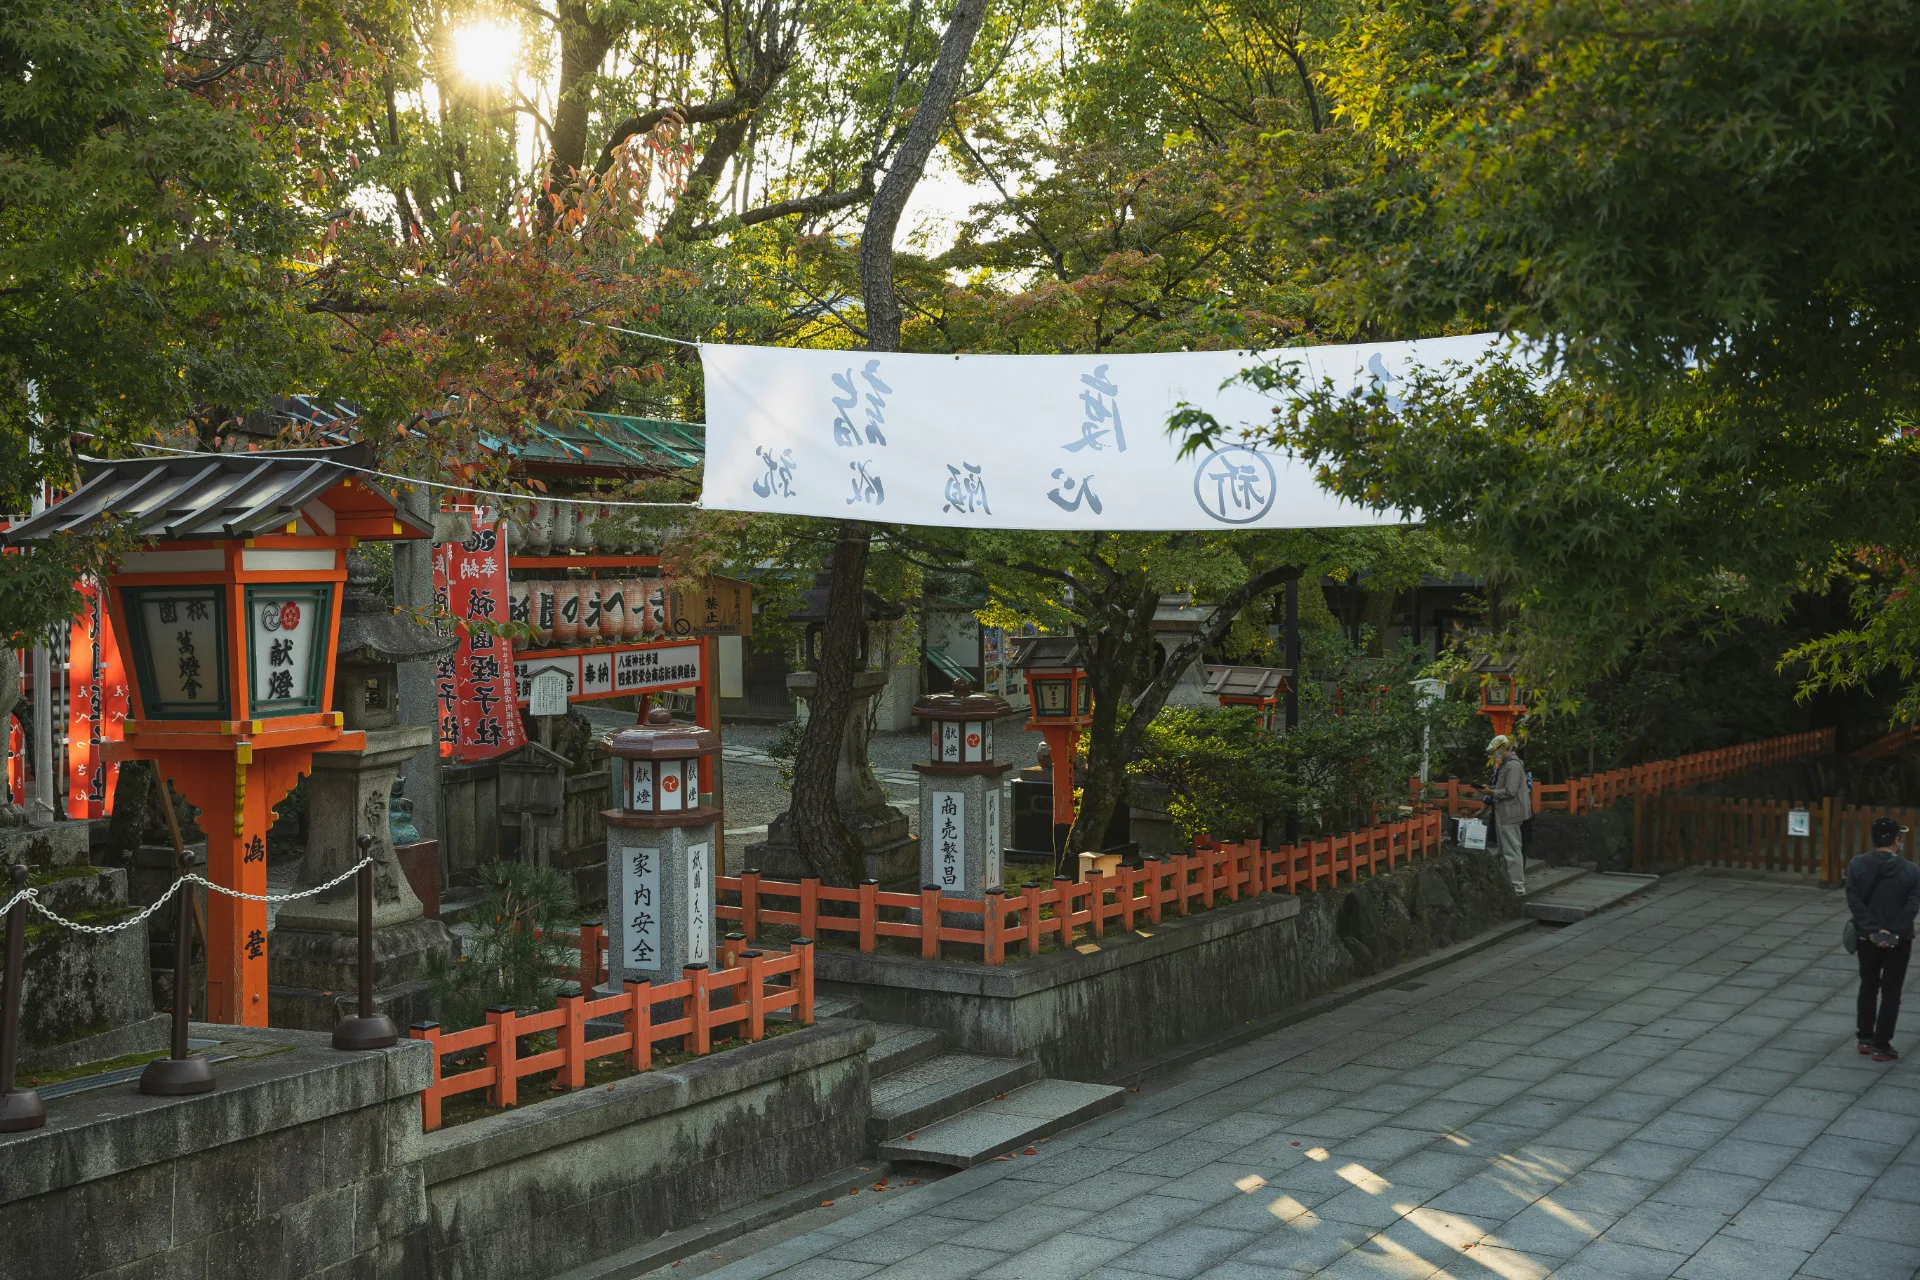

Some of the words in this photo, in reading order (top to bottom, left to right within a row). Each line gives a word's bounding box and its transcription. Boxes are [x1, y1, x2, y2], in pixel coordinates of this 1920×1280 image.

[705, 596, 719, 623] 禁止
[268, 638, 294, 700] 献燈
[584, 662, 609, 685] 奉納
[618, 651, 659, 669] 八坂神社参道
[630, 853, 655, 963] 家内安全
